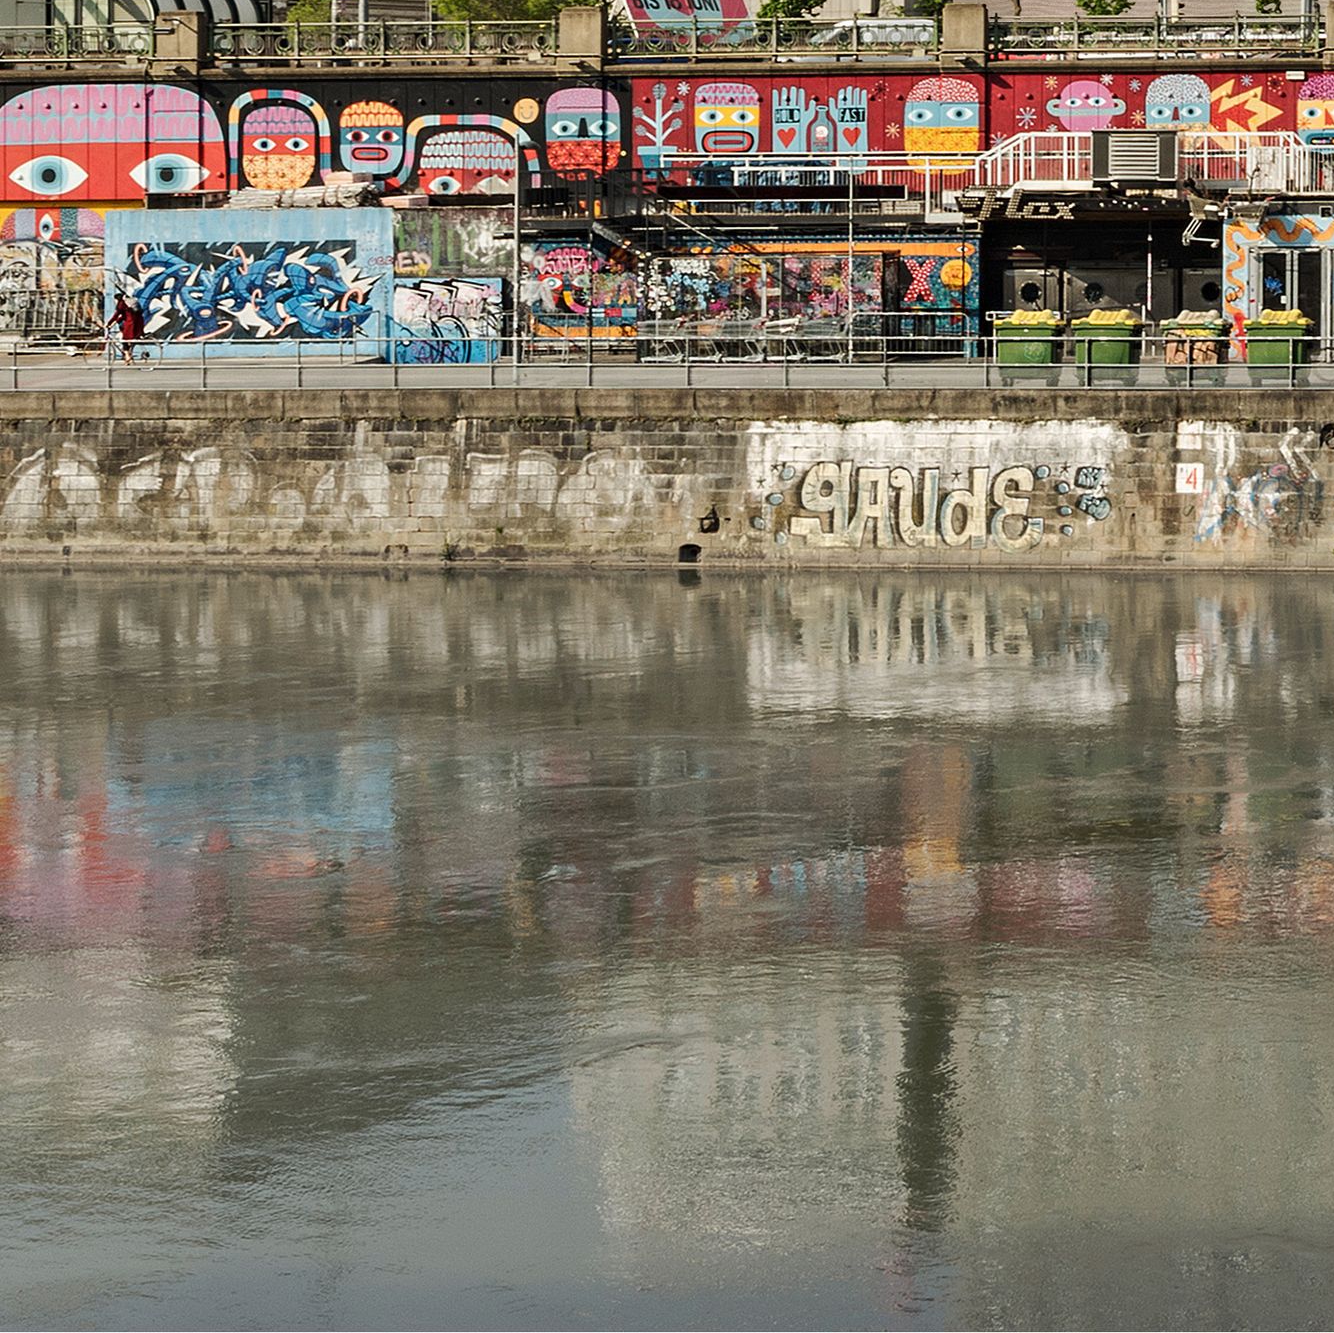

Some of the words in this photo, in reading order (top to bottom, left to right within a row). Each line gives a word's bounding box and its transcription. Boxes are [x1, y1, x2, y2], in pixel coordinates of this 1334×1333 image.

[774, 108, 801, 123] HOLD
[839, 108, 866, 122] FAST
[1186, 468, 1198, 490] 4
